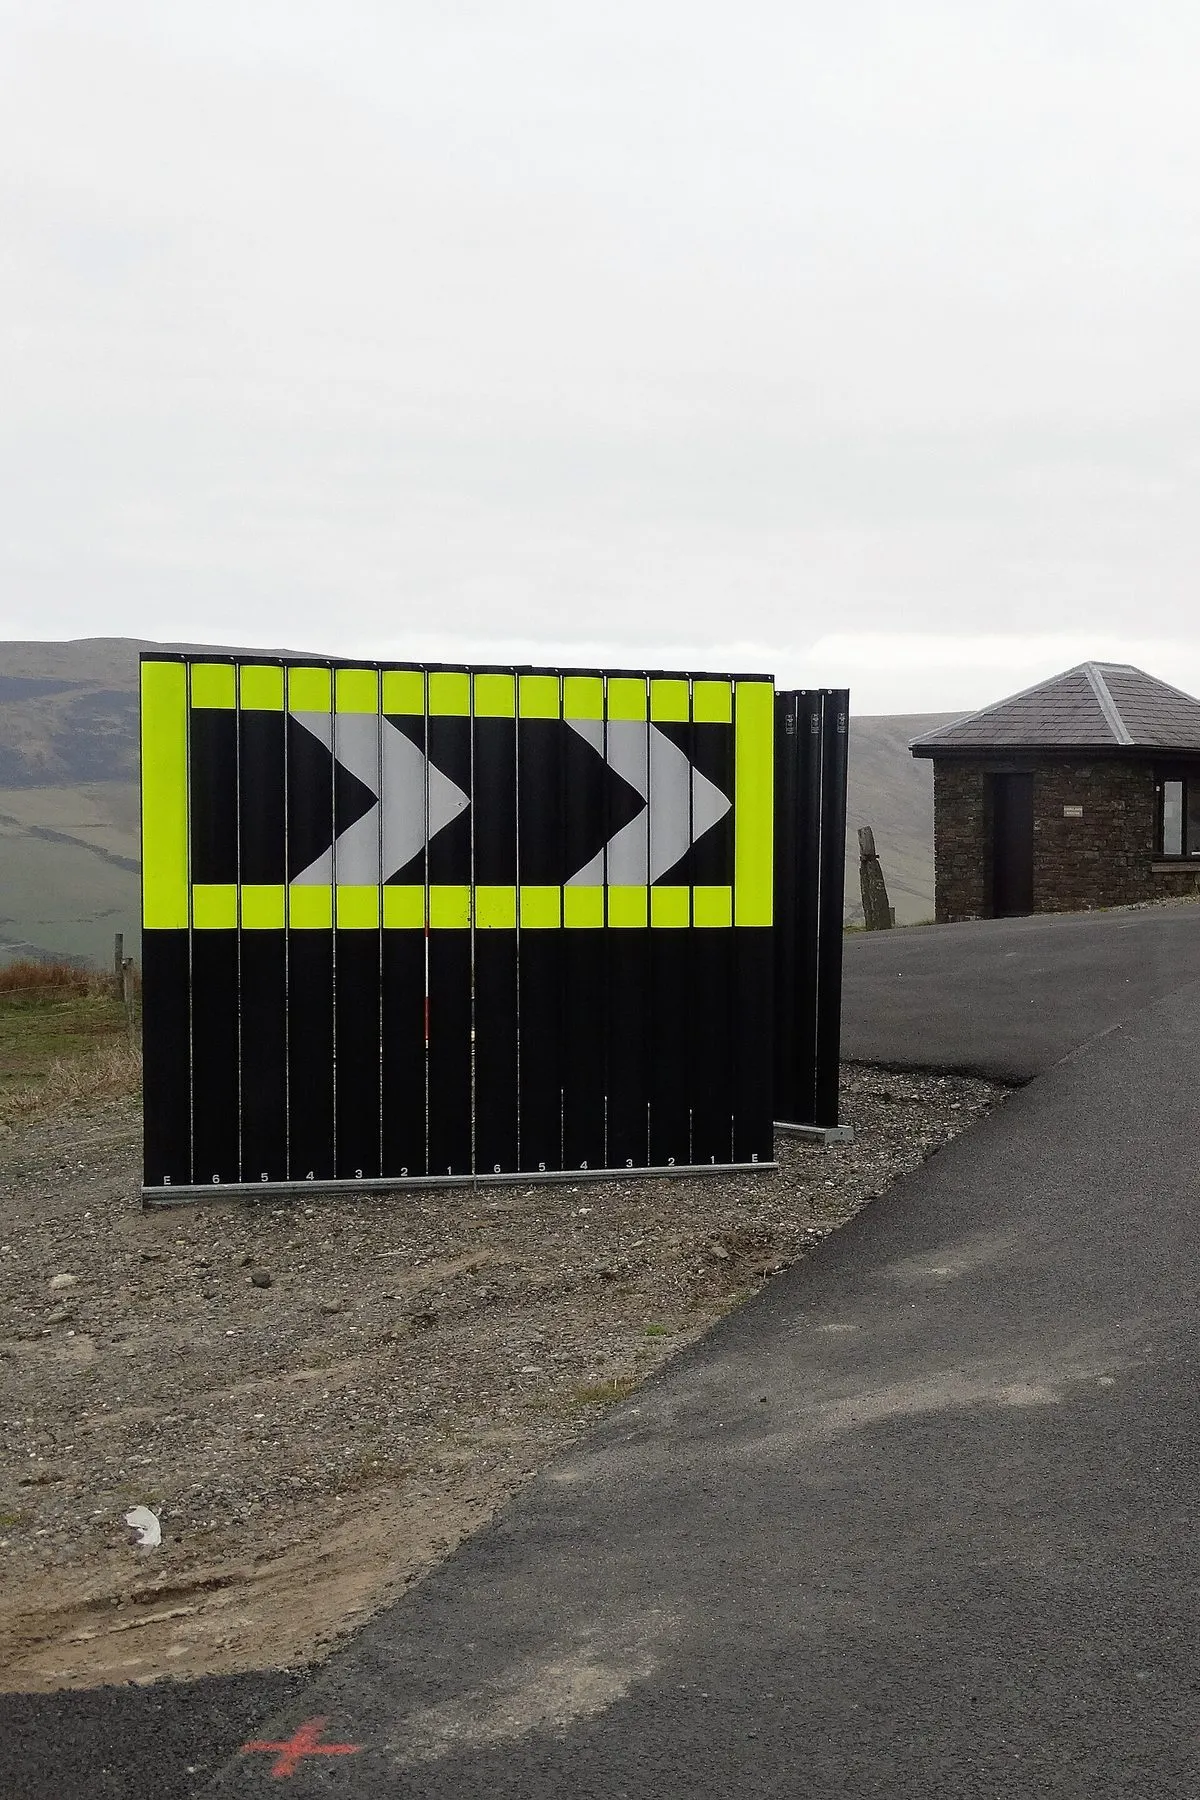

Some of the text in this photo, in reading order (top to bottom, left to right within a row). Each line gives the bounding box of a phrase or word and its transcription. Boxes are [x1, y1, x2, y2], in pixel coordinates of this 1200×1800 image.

[163, 1154, 758, 1185] E 6 5 4 3 2 1 6 5 4 3 2 1 E
